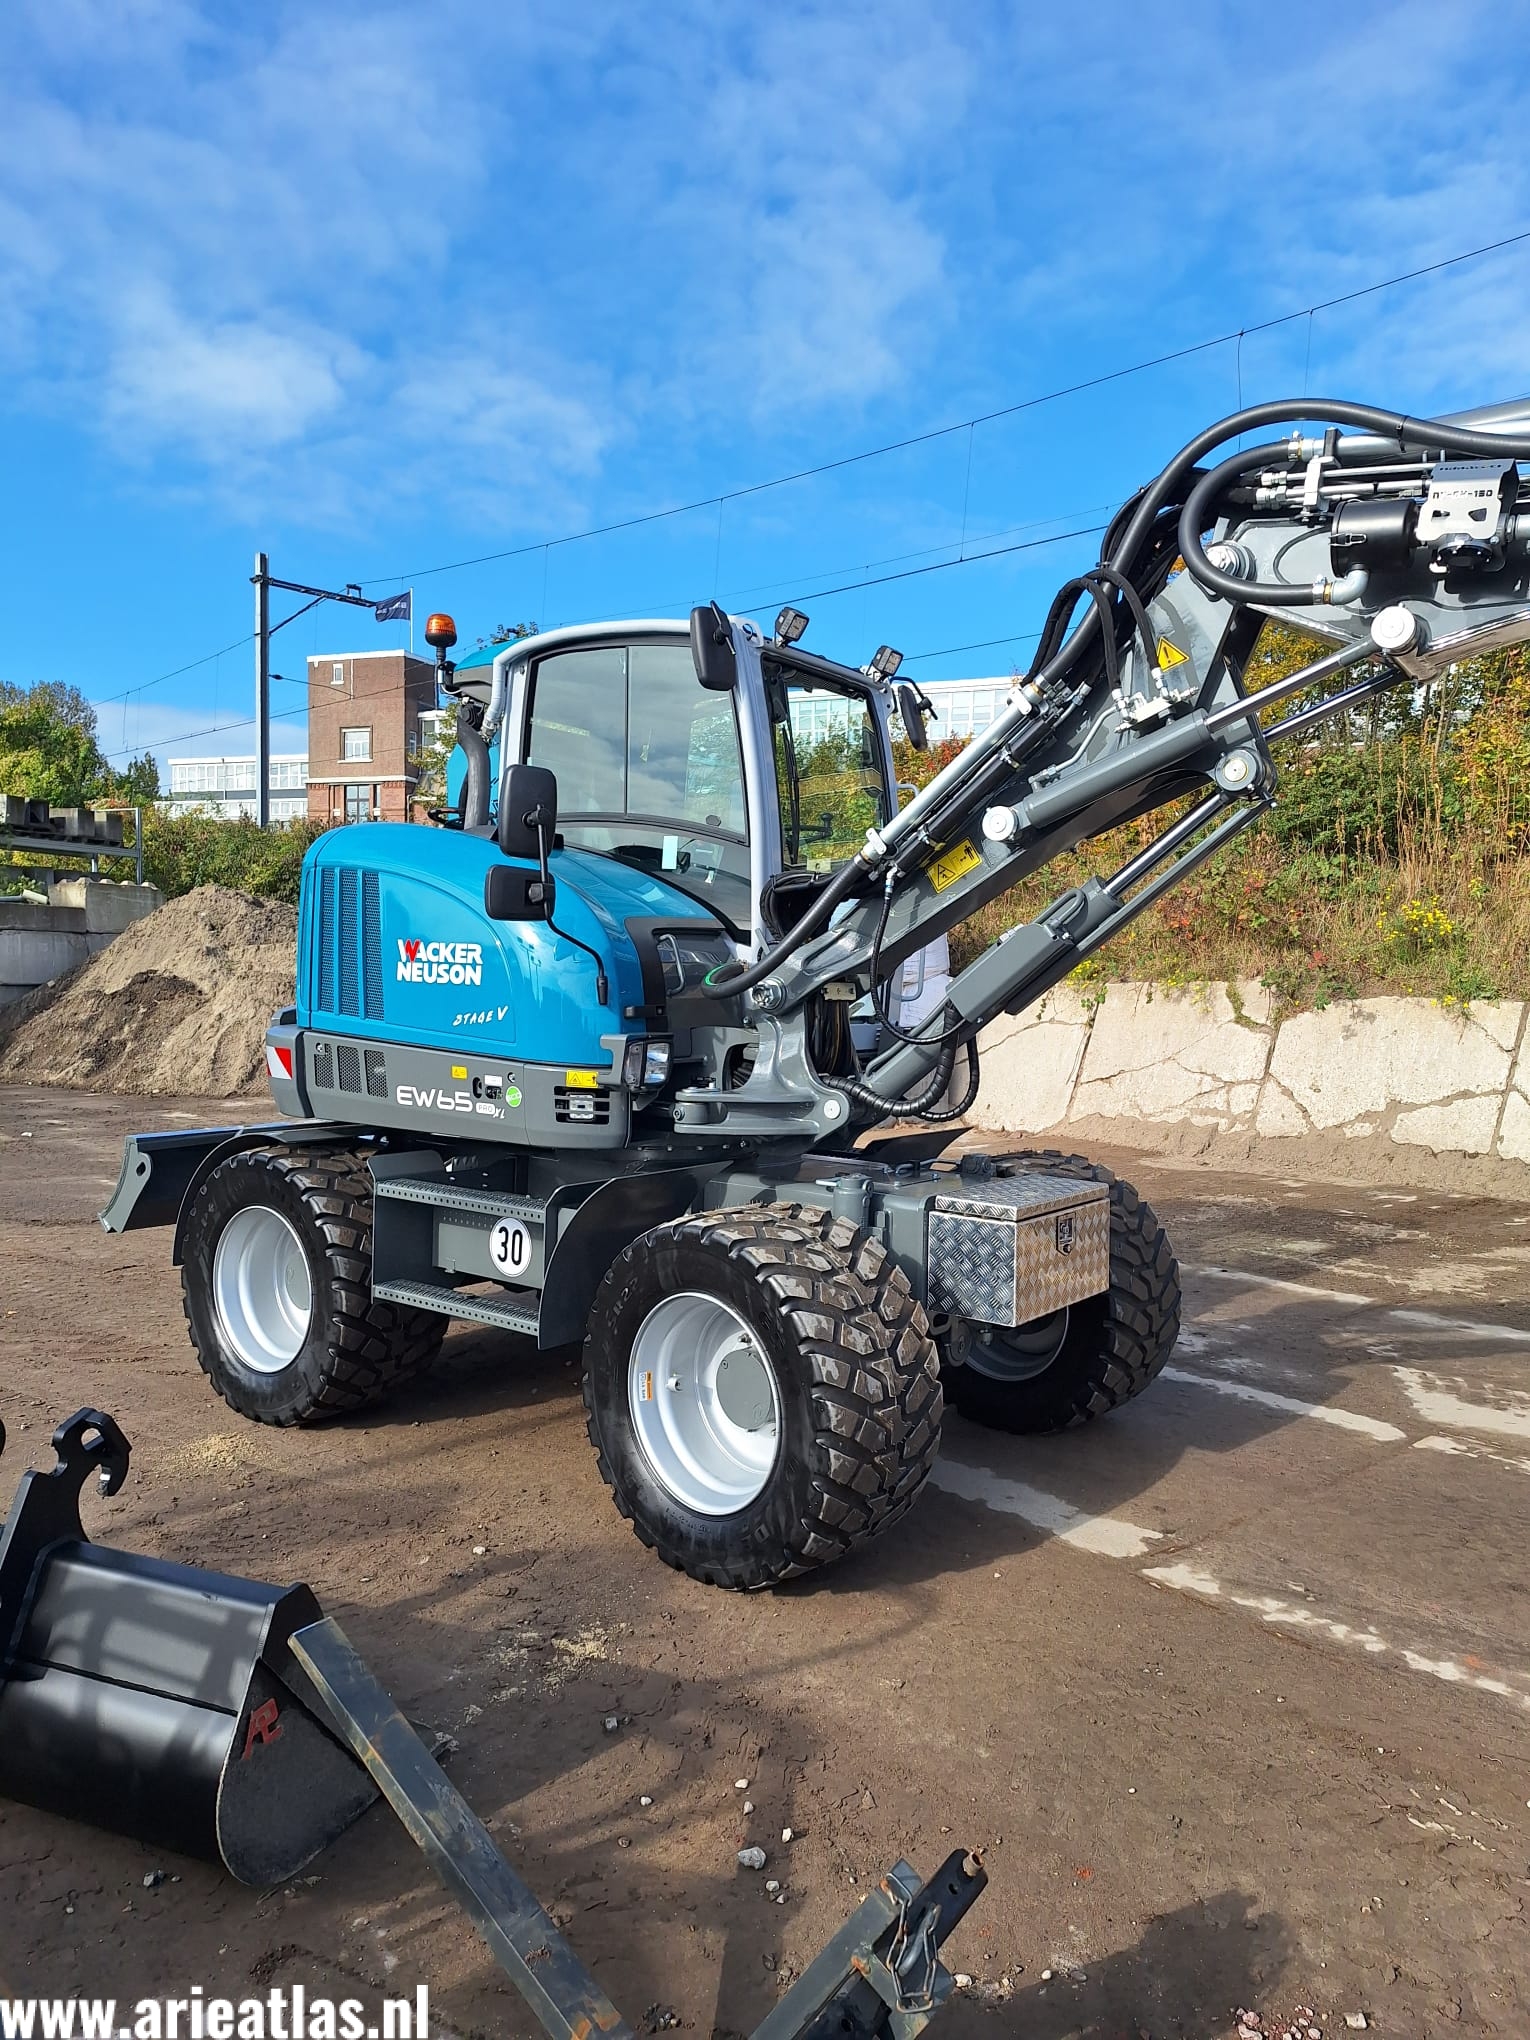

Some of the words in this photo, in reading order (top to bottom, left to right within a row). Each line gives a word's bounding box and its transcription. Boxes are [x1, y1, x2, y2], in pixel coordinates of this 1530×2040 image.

[397, 939, 484, 965] WACKER
[396, 961, 482, 986] NEUSON
[452, 1010, 494, 1026] STAGE
[497, 1005, 509, 1021] V
[396, 1085, 473, 1113] EW65
[497, 1226, 523, 1266] 30
